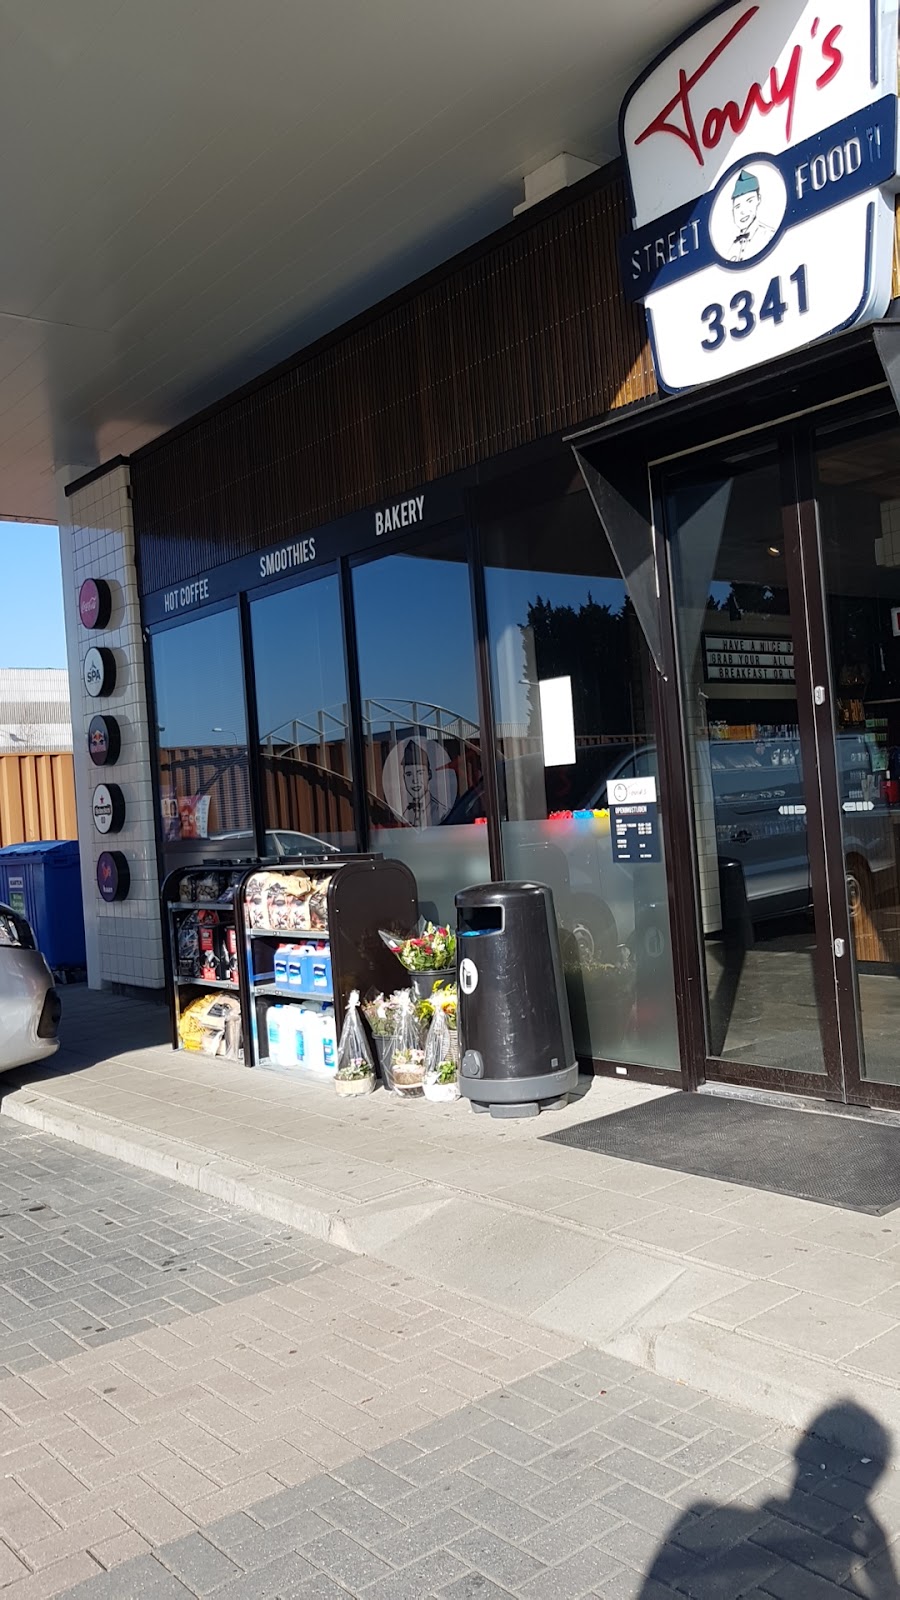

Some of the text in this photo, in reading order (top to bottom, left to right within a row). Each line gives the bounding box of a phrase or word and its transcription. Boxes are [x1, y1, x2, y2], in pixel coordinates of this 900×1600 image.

[633, 5, 844, 166] Tony's
[631, 136, 862, 280] STREET FOOD
[700, 263, 809, 351] 3341
[375, 495, 425, 536] BAKERY
[259, 537, 316, 577] SMOOTHIES
[164, 578, 209, 613] HOT COFFEE
[711, 653, 788, 666] GRAB YOUR ALL
[723, 640, 744, 651] HAVE
[751, 641, 756, 651] A
[760, 641, 781, 652] NICE
[87, 669, 101, 683] SPA
[719, 668, 768, 679] BREAKFAST
[773, 669, 784, 679] OR
